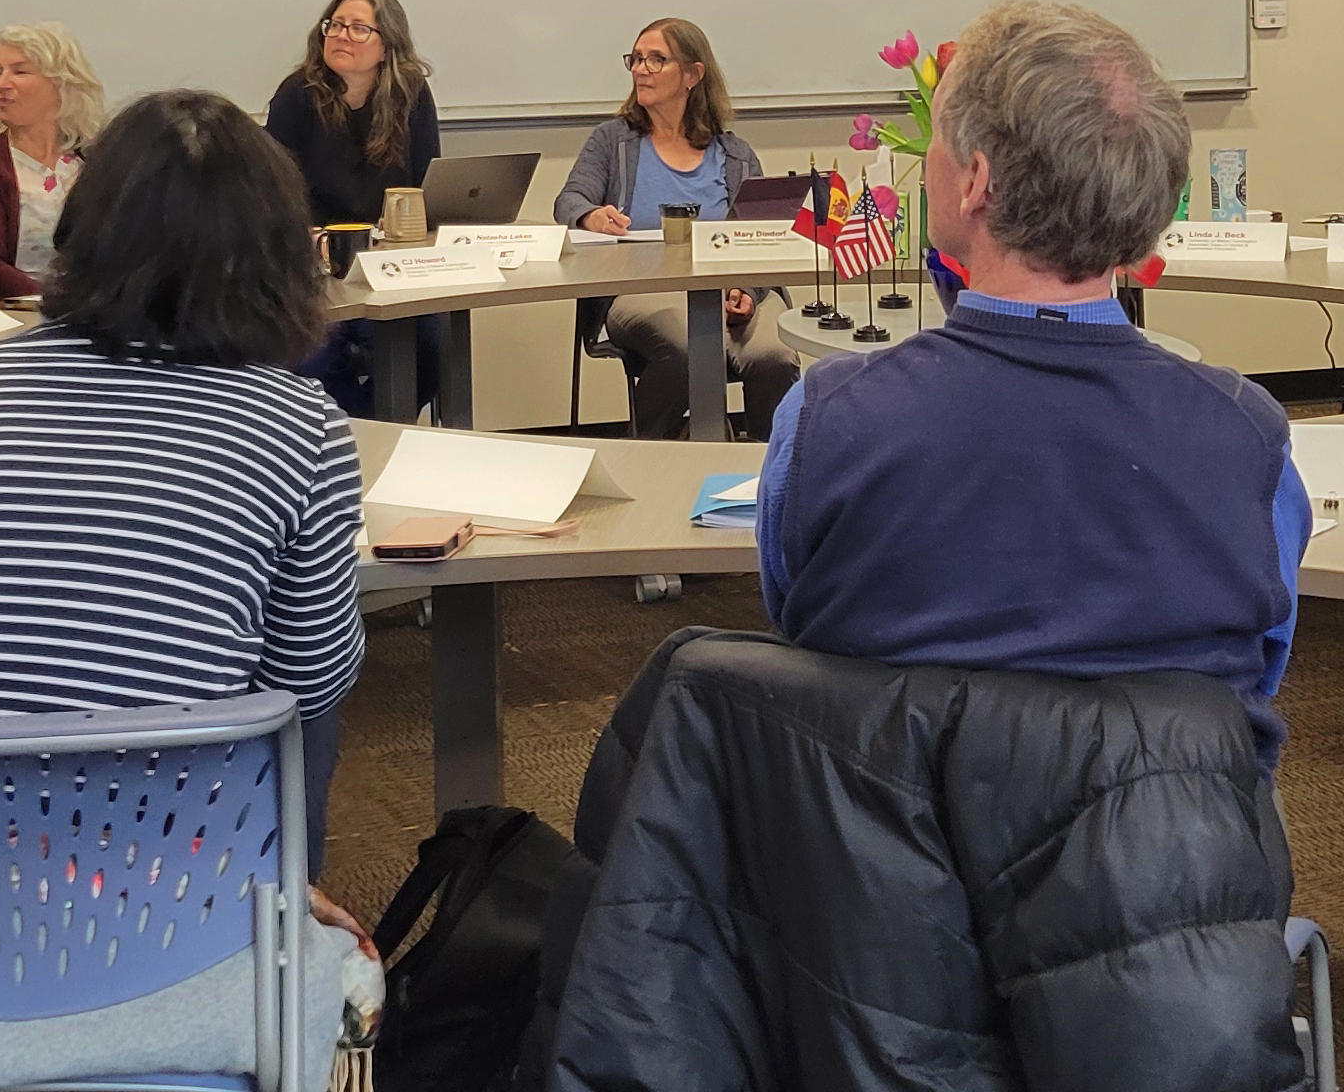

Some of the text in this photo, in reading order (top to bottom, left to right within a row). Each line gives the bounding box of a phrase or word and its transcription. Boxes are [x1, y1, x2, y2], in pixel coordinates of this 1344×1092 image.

[734, 231, 754, 239] Mary
[1225, 231, 1246, 239] Beck
[415, 256, 446, 265] Howard
